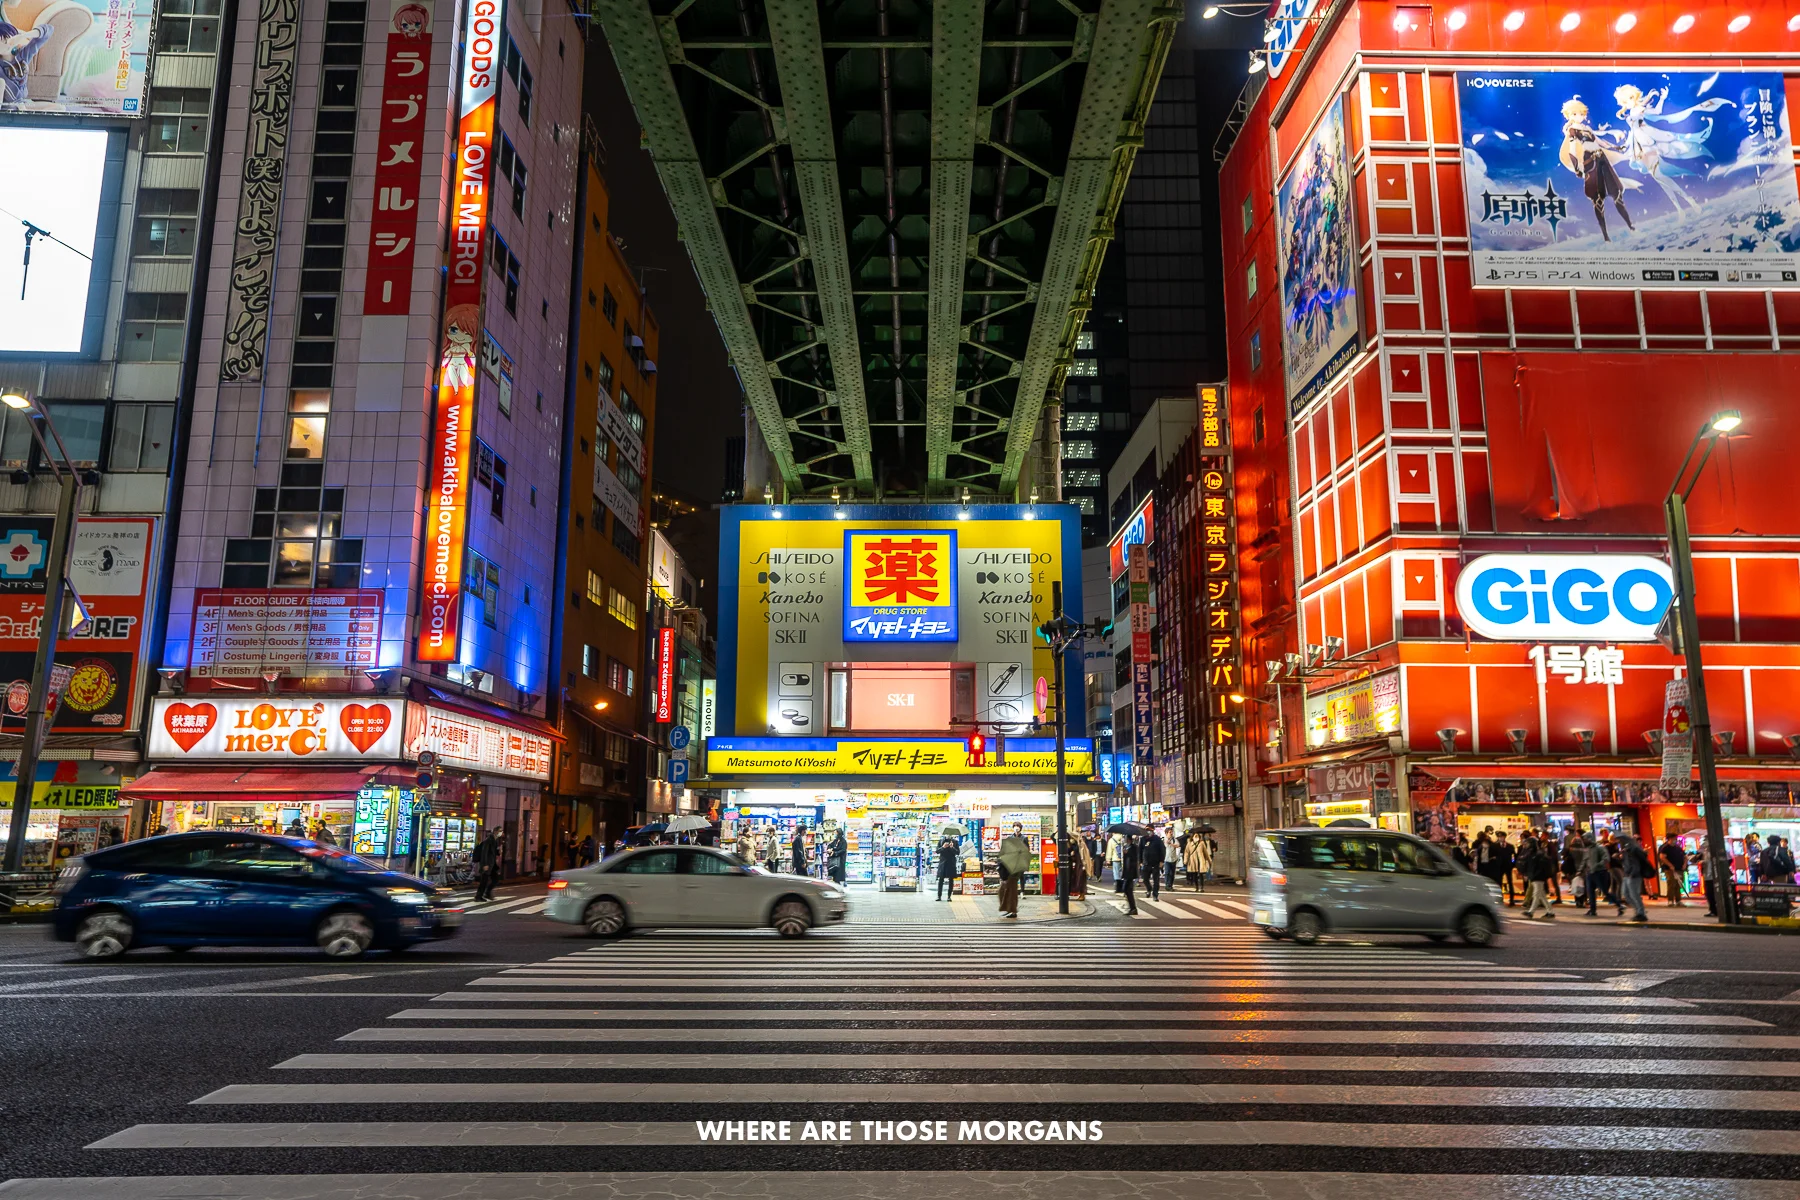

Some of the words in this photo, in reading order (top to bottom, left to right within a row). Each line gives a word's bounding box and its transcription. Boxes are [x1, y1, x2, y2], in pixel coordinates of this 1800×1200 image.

[469, 0, 496, 89] GOODS
[1466, 77, 1534, 88] HOYOVERSE
[460, 131, 486, 196] LOVE
[374, 52, 425, 303] ラブメルシー
[1480, 178, 1567, 243] 原神
[454, 203, 481, 284] MERCI
[1504, 270, 1538, 280] PS5
[1548, 270, 1582, 280] PS4
[1589, 270, 1636, 280] Windows
[1293, 384, 1316, 412] Welcome
[1324, 343, 1357, 384] Akihabara
[1201, 388, 1220, 447] 電子部品
[429, 405, 460, 648] www.akibalovemerci.com
[750, 551, 834, 565] SHISEIDO
[967, 551, 1052, 566] SHISEIDO
[784, 571, 827, 584] KOSÉ
[864, 538, 940, 604] 薬
[1004, 571, 1046, 584] KOSÉ
[234, 597, 268, 605] FLOOR
[269, 597, 298, 605] GUIDE
[758, 590, 824, 606] Kanebo
[978, 590, 1043, 606] Kanebo
[1471, 567, 1673, 626] GiGO
[204, 609, 219, 618] 4F
[228, 610, 254, 618] Men's
[256, 610, 287, 618] Goods
[295, 609, 328, 617] 男性用品
[763, 612, 820, 624] SOFINA
[983, 612, 1040, 624] SOFINA
[1204, 498, 1233, 745] 東京ラジオデパート
[202, 623, 218, 632] 3F
[226, 624, 252, 632] Men's
[255, 624, 286, 632] Goods
[294, 624, 326, 632] 男性用品
[850, 616, 951, 638] マツモトキヨシ
[201, 638, 216, 646] 2F
[225, 638, 266, 647] Couple's
[268, 638, 299, 646] Goods
[308, 638, 340, 646] 女士用品
[200, 652, 214, 660] 1F
[224, 652, 267, 660] Costume
[269, 652, 307, 662] Lingerie
[1528, 645, 1624, 685] 1号館
[198, 666, 212, 676] B1
[222, 666, 250, 674] Fetish
[171, 714, 208, 728] 秋葉原
[234, 704, 320, 730] LOVE
[704, 698, 712, 732] mouse
[421, 754, 432, 762] 20
[726, 758, 792, 768] Matsumoto
[794, 758, 836, 768] KiYoshi
[852, 748, 948, 770] マツモトキヨシ
[1032, 758, 1074, 768] KiYohi
[673, 762, 685, 781] P
[1336, 767, 1362, 790] 宝くじ
[972, 803, 990, 811] Free
